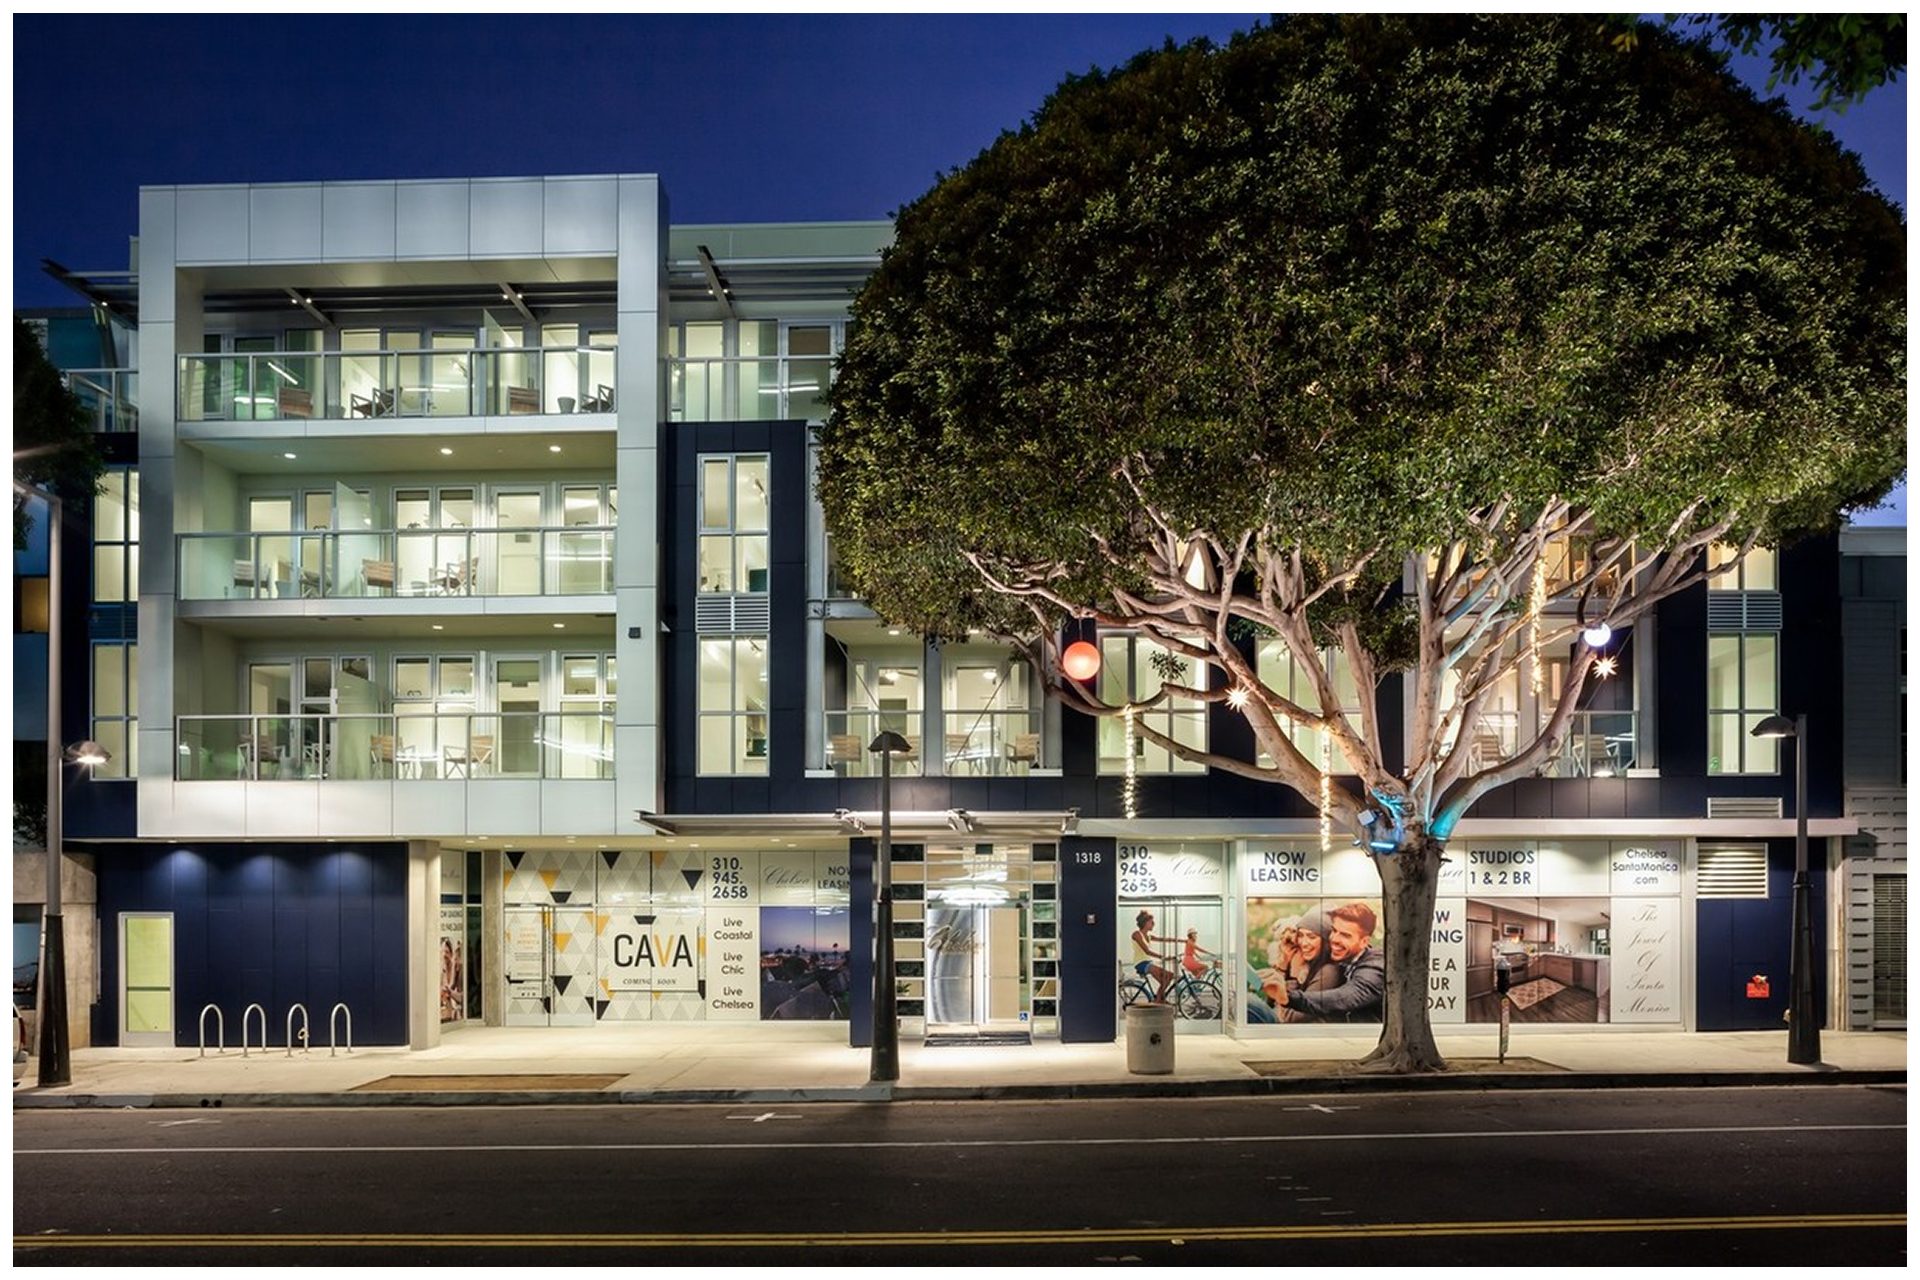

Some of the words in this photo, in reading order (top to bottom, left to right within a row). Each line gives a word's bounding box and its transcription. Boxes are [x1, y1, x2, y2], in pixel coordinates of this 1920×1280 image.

[1075, 852, 1101, 864] 1318
[1119, 846, 1152, 860] 310.
[1264, 851, 1306, 866] NOW
[1470, 850, 1535, 864] STUDIOS
[1626, 848, 1668, 859] Chelsea
[712, 857, 743, 870] 310.
[1120, 862, 1152, 876] 945.
[1612, 861, 1679, 872] SantaMonica
[713, 871, 743, 884] 945.
[1250, 868, 1319, 882] LEASING
[1470, 871, 1476, 885] 1
[1483, 871, 1494, 885] &
[1498, 871, 1508, 885] 2
[1513, 871, 1532, 885] BR
[1632, 876, 1659, 885] .com
[817, 879, 850, 890] LEASI
[1120, 878, 1158, 892] 2658
[712, 885, 748, 899] 2658
[1632, 903, 1657, 921] The
[723, 917, 743, 927] Live
[713, 930, 753, 940] Coastal
[614, 933, 694, 968] CAVA
[723, 952, 743, 962] Live
[721, 965, 745, 975] Chic
[622, 978, 652, 986] COMING
[657, 978, 677, 986] SOON
[1430, 976, 1450, 991] UR
[723, 986, 743, 997] Live
[712, 999, 754, 1010] Chelsea
[1427, 996, 1457, 1010] DAY
[1620, 996, 1670, 1014] Monica
